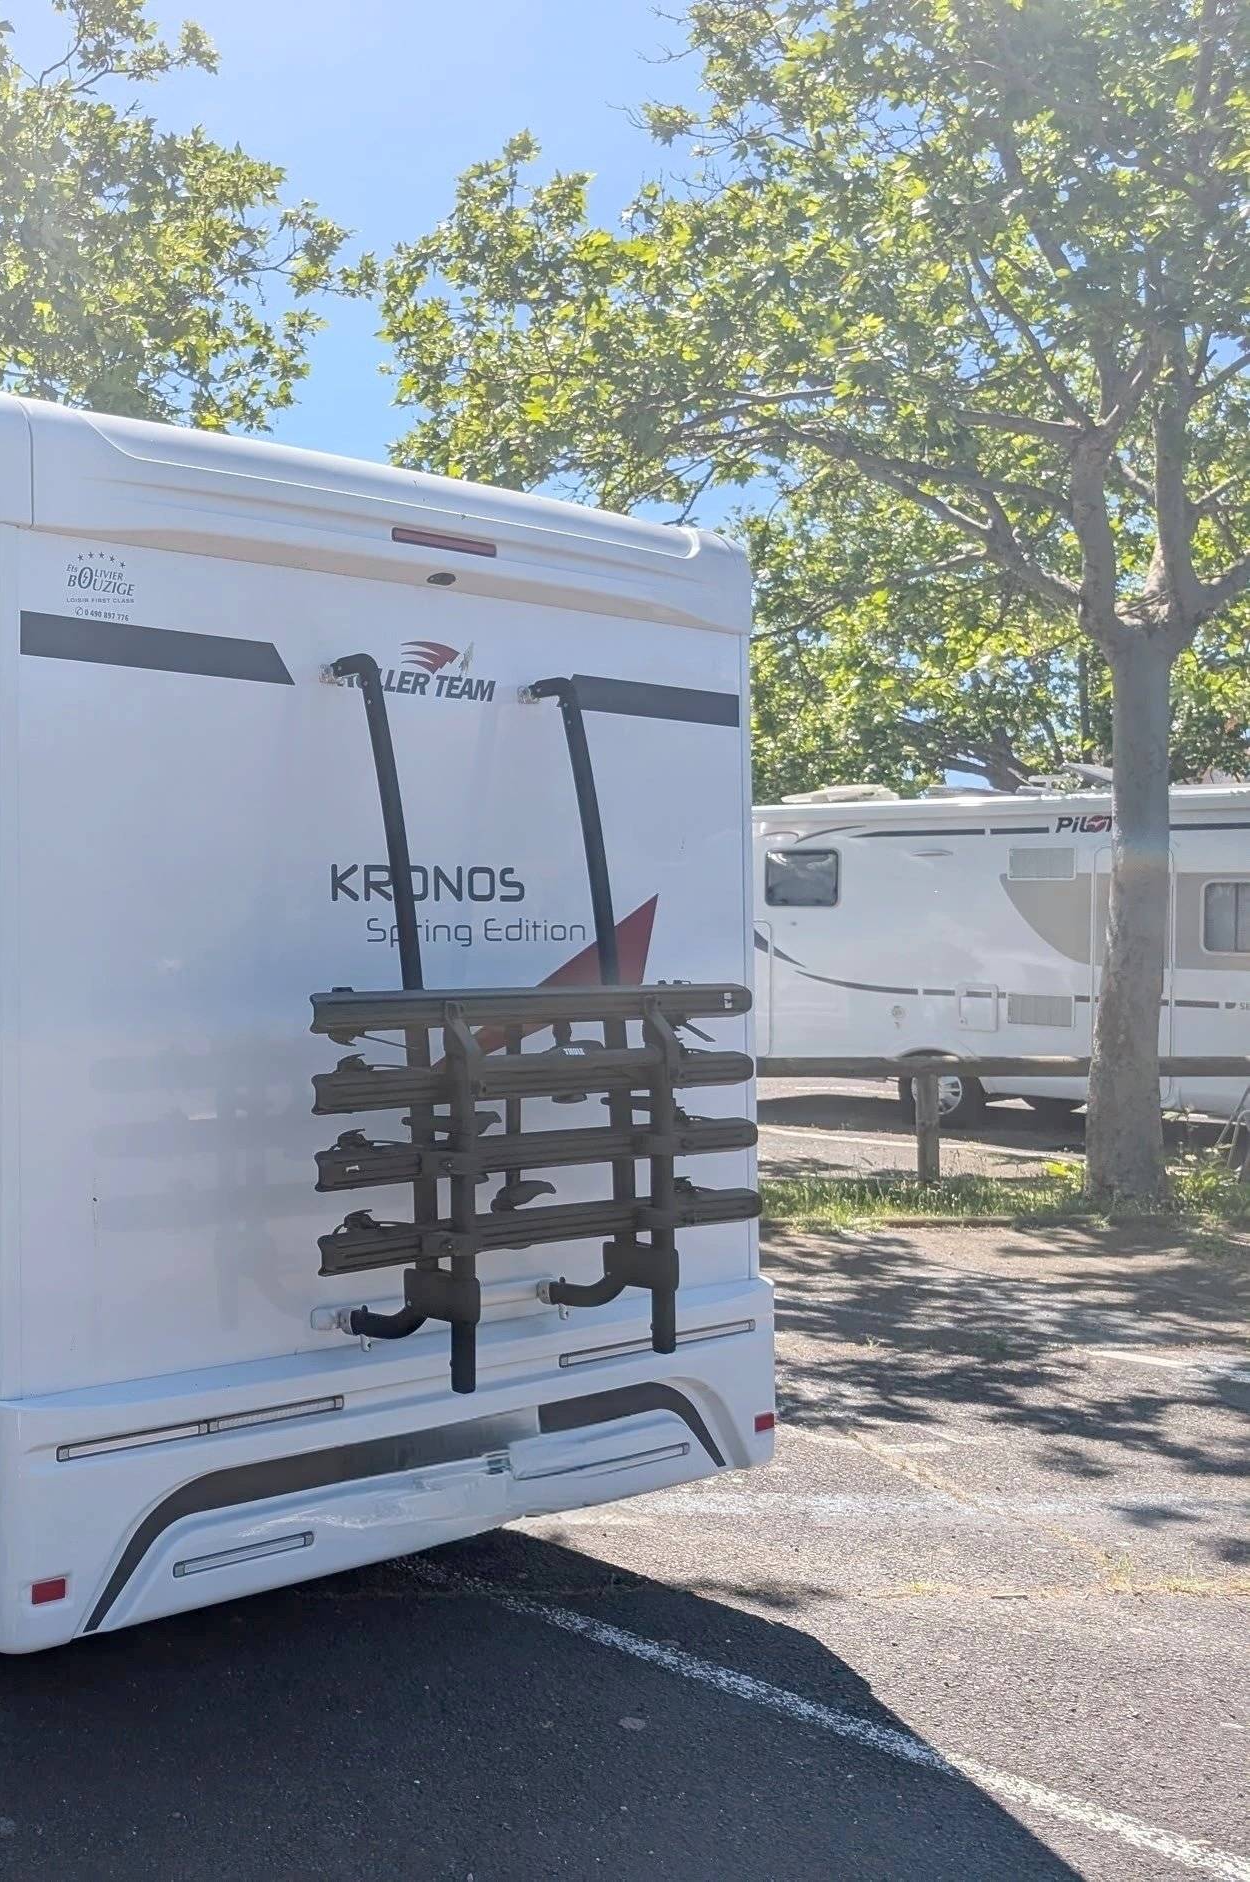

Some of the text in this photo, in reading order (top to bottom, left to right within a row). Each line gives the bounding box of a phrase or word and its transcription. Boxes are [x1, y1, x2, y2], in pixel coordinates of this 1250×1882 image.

[67, 566, 135, 597] BOUZIGE
[434, 673, 497, 703] TEAM
[330, 863, 525, 903] KRONOS
[366, 917, 587, 948] Sping Edition
